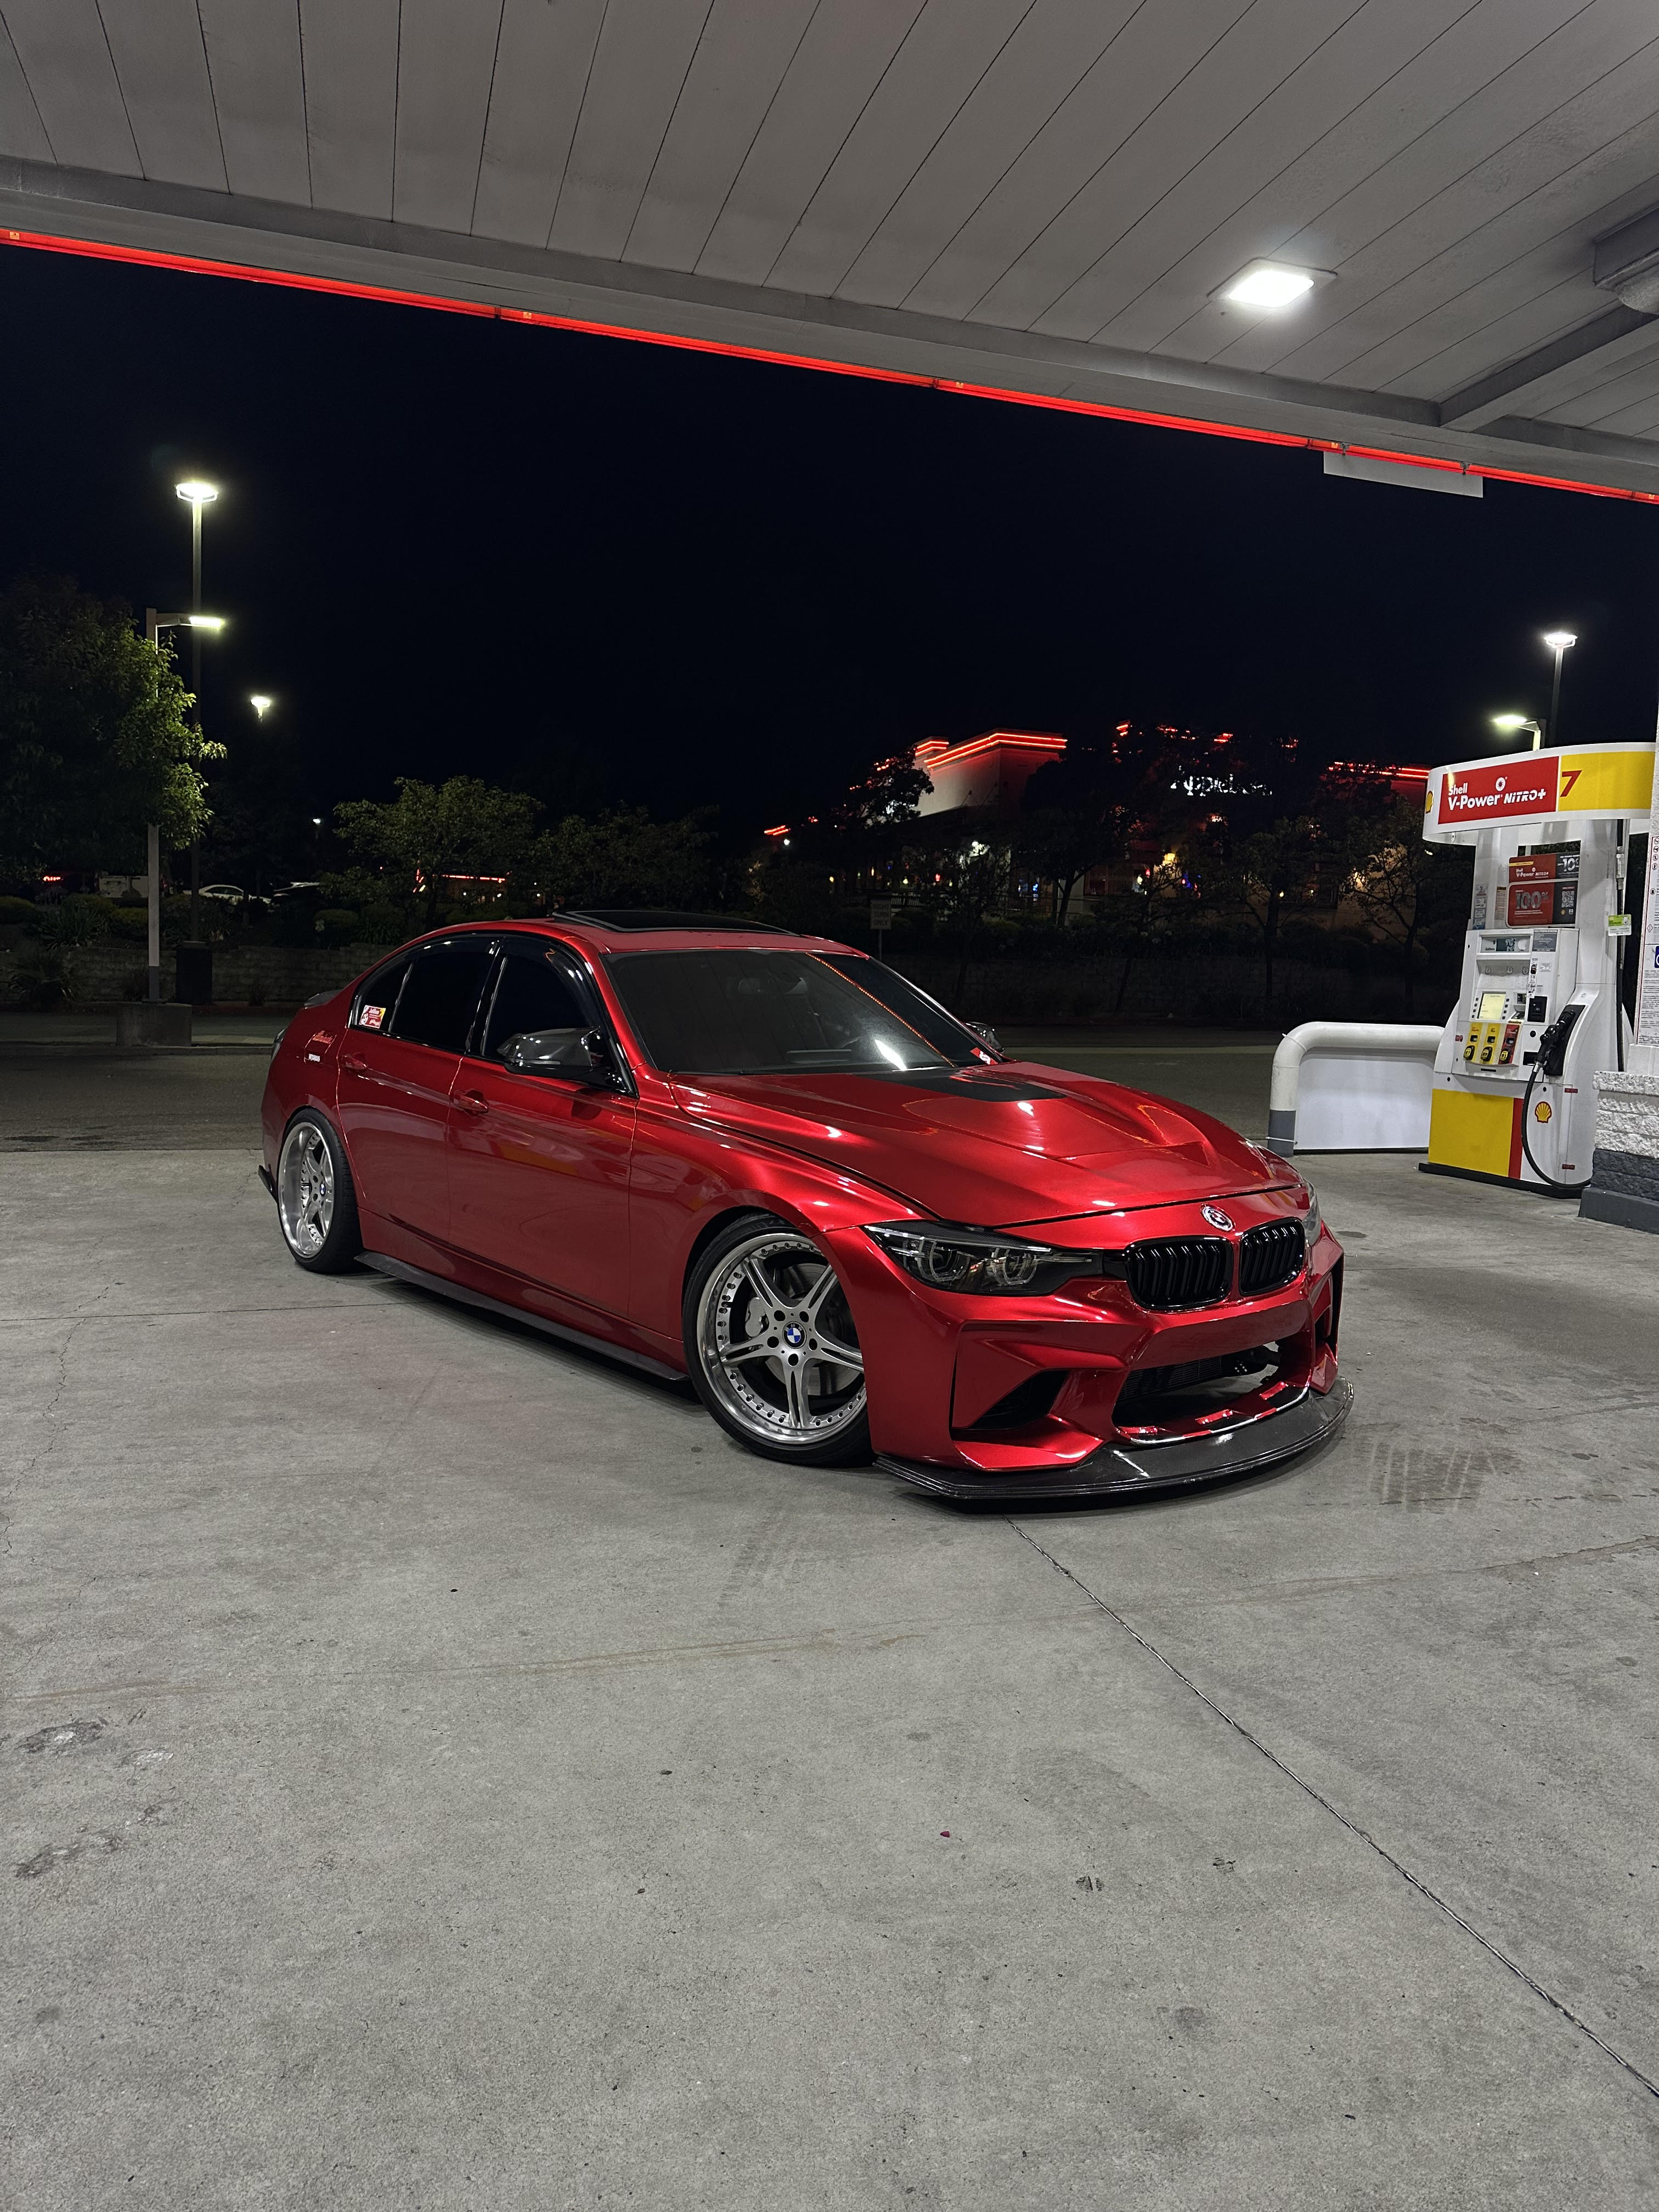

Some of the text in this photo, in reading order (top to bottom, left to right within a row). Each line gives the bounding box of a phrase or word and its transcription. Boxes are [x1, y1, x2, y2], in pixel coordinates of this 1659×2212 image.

[1448, 783, 1468, 795] Shell
[1560, 770, 1582, 797] 7
[1448, 795, 1500, 810] V-Power
